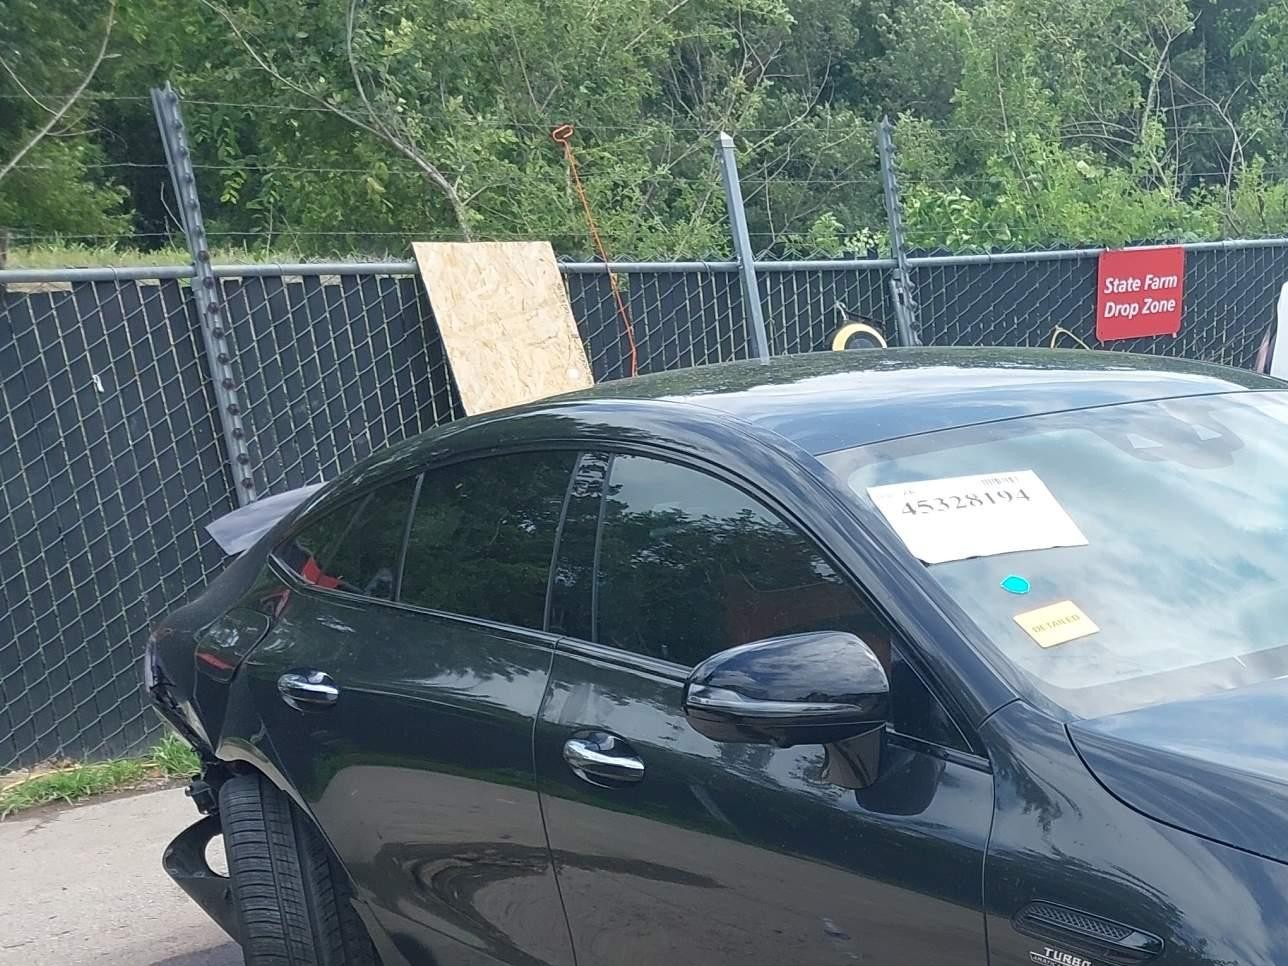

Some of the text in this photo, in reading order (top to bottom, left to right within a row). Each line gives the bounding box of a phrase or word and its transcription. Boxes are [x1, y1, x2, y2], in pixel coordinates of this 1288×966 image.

[1104, 274, 1177, 294] State Farm
[1104, 299, 1175, 319] Drop Zone
[902, 489, 1032, 515] 45328194
